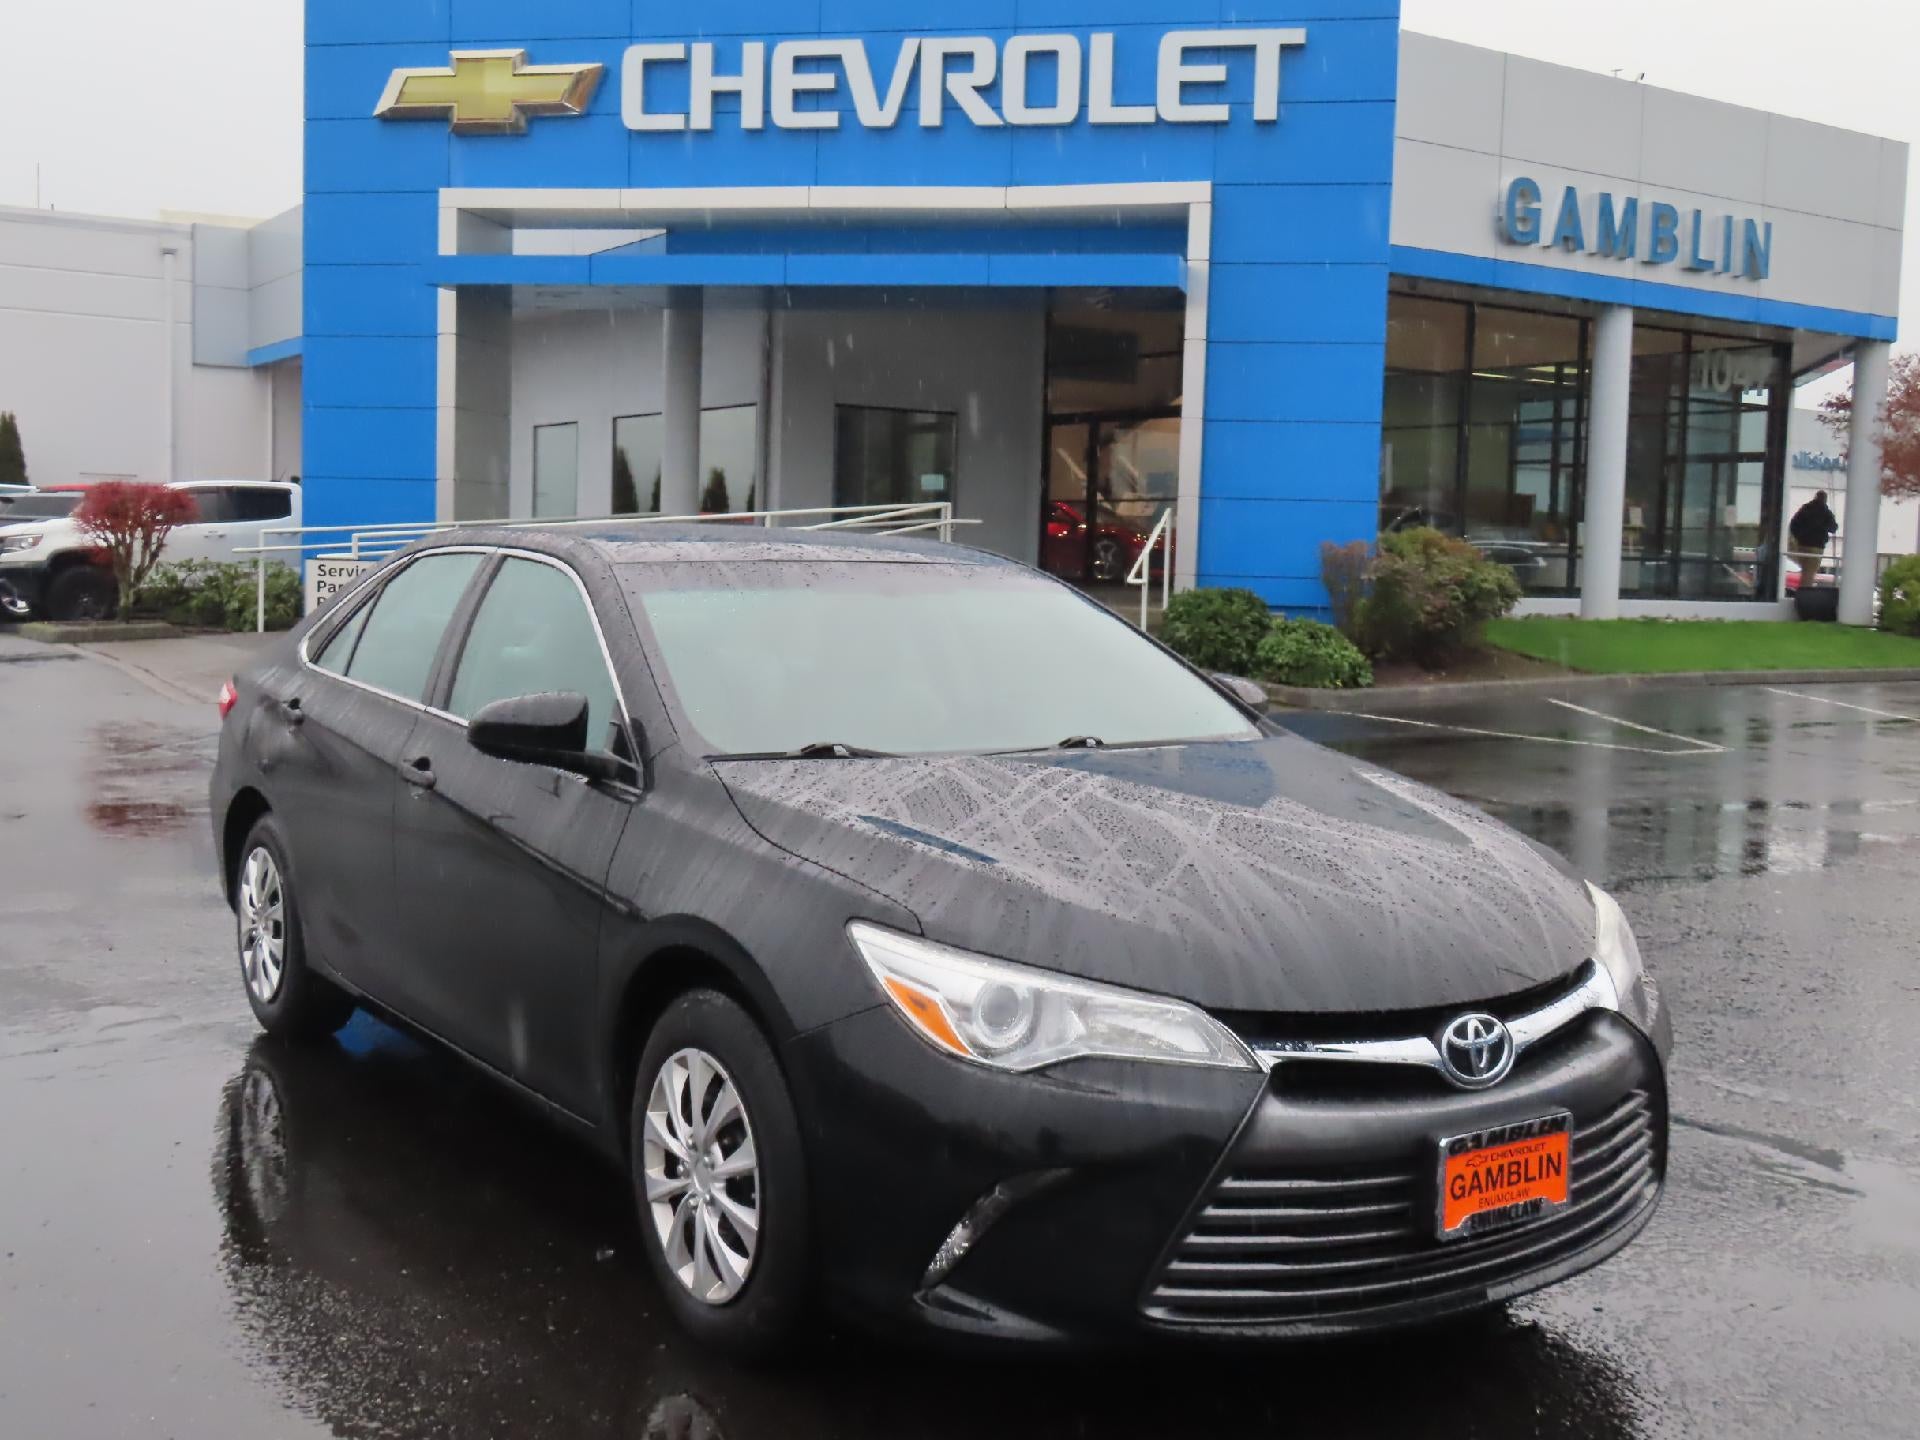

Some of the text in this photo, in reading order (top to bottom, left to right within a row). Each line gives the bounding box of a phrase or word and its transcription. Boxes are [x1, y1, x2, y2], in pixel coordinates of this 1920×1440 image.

[620, 26, 1308, 132] CHEVROLET
[1500, 175, 1772, 281] GAMBLIN
[1450, 1152, 1562, 1200] GAMBLIN
[1490, 1142, 1546, 1162] CHEVROLET
[1478, 1187, 1531, 1209] ENUMCLAW
